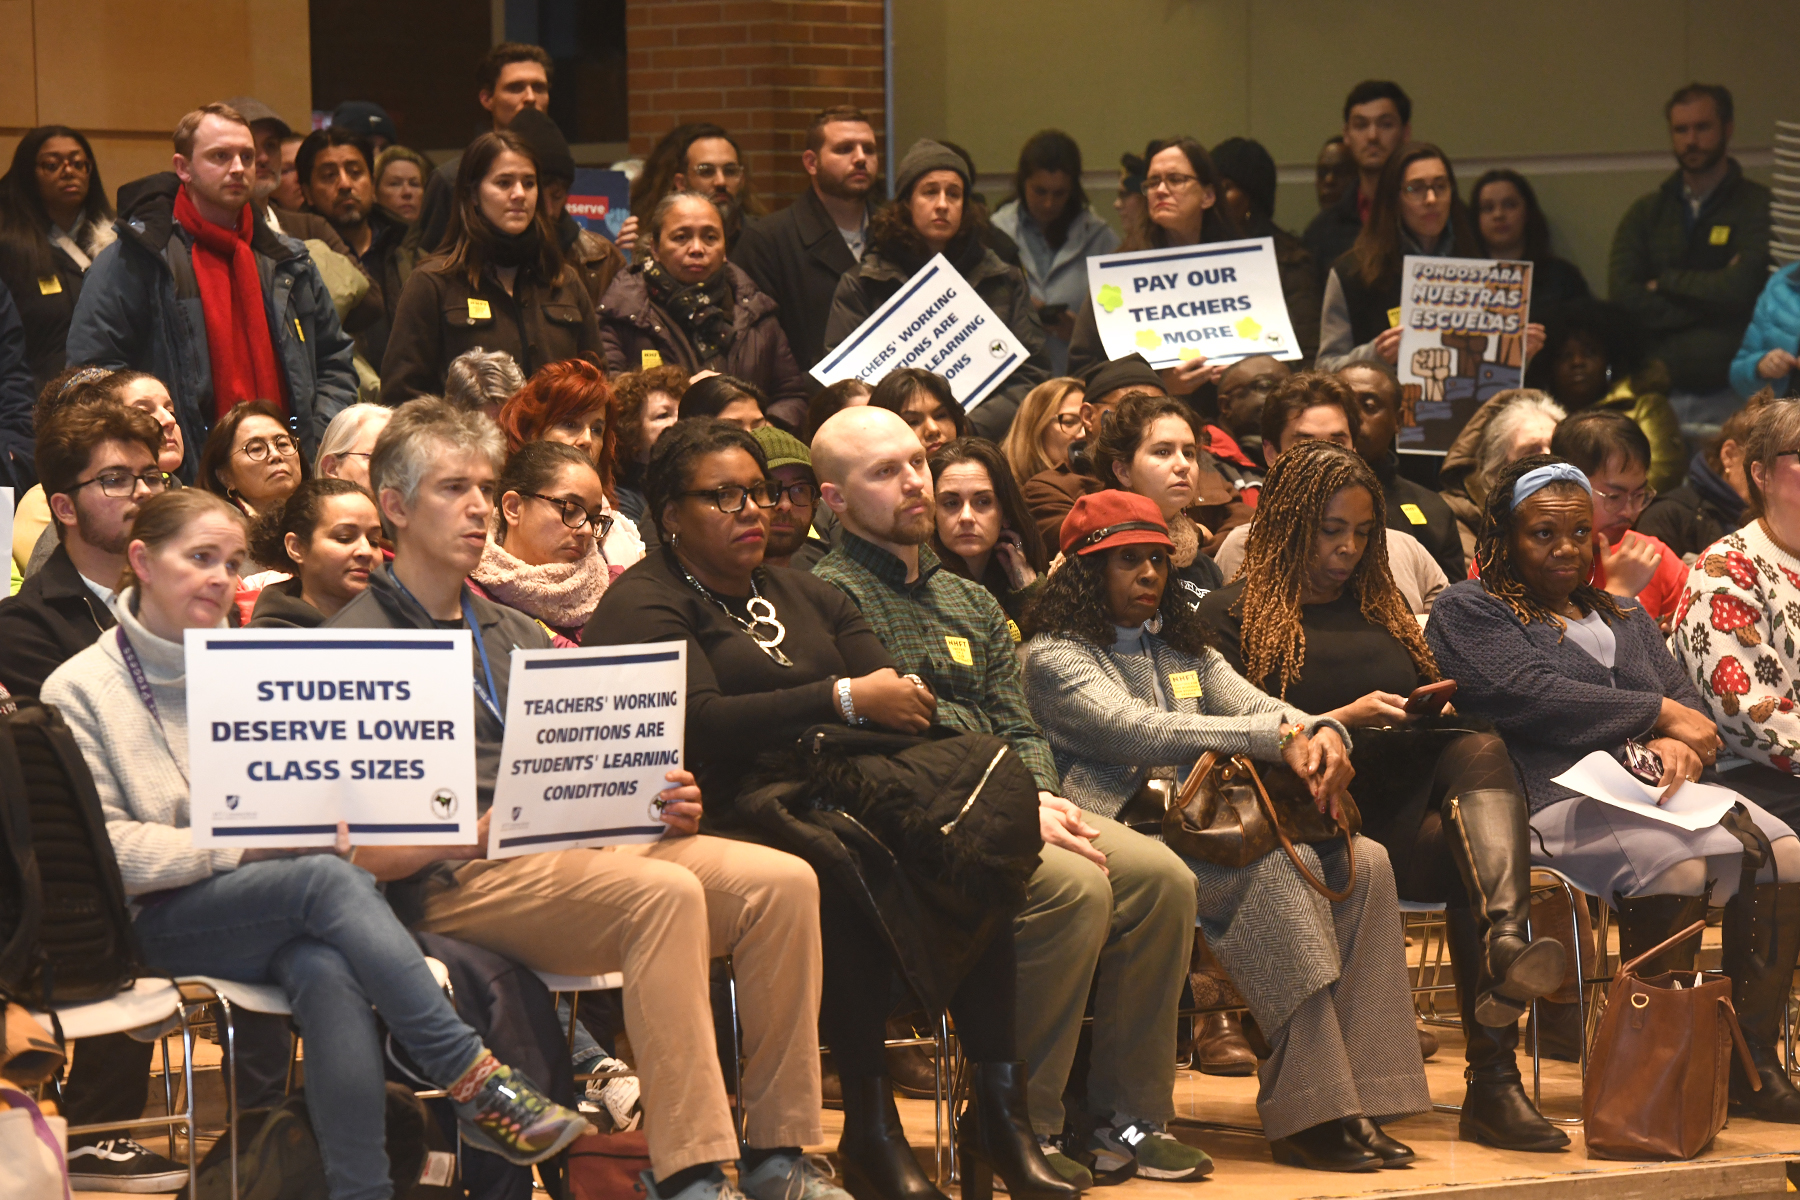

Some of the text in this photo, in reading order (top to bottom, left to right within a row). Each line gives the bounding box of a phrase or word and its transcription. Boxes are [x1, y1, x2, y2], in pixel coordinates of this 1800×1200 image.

[564, 203, 605, 215] eserve
[1133, 267, 1237, 293] PAY OUR
[1411, 282, 1522, 308] NUESTRAS
[1129, 295, 1252, 323] TEACHERS
[1409, 309, 1521, 333] ESCUELAS
[855, 341, 896, 383] ACHERS'
[898, 287, 957, 343] WORKING
[891, 336, 932, 372] TIONS
[933, 312, 959, 339] ARE
[924, 314, 985, 371] LEARNING
[1162, 326, 1234, 345] MORE
[257, 680, 411, 701] STUDENTS
[524, 696, 609, 716] TEACHERS'
[613, 690, 678, 711] WORKING
[211, 720, 455, 742] DESERVE LOWER
[536, 721, 665, 744] CONDITIONS ARE
[247, 759, 425, 782] CLASS SIZES
[511, 749, 679, 775] STUDENTS' LEARNING
[543, 780, 638, 801] CONDITIONS
